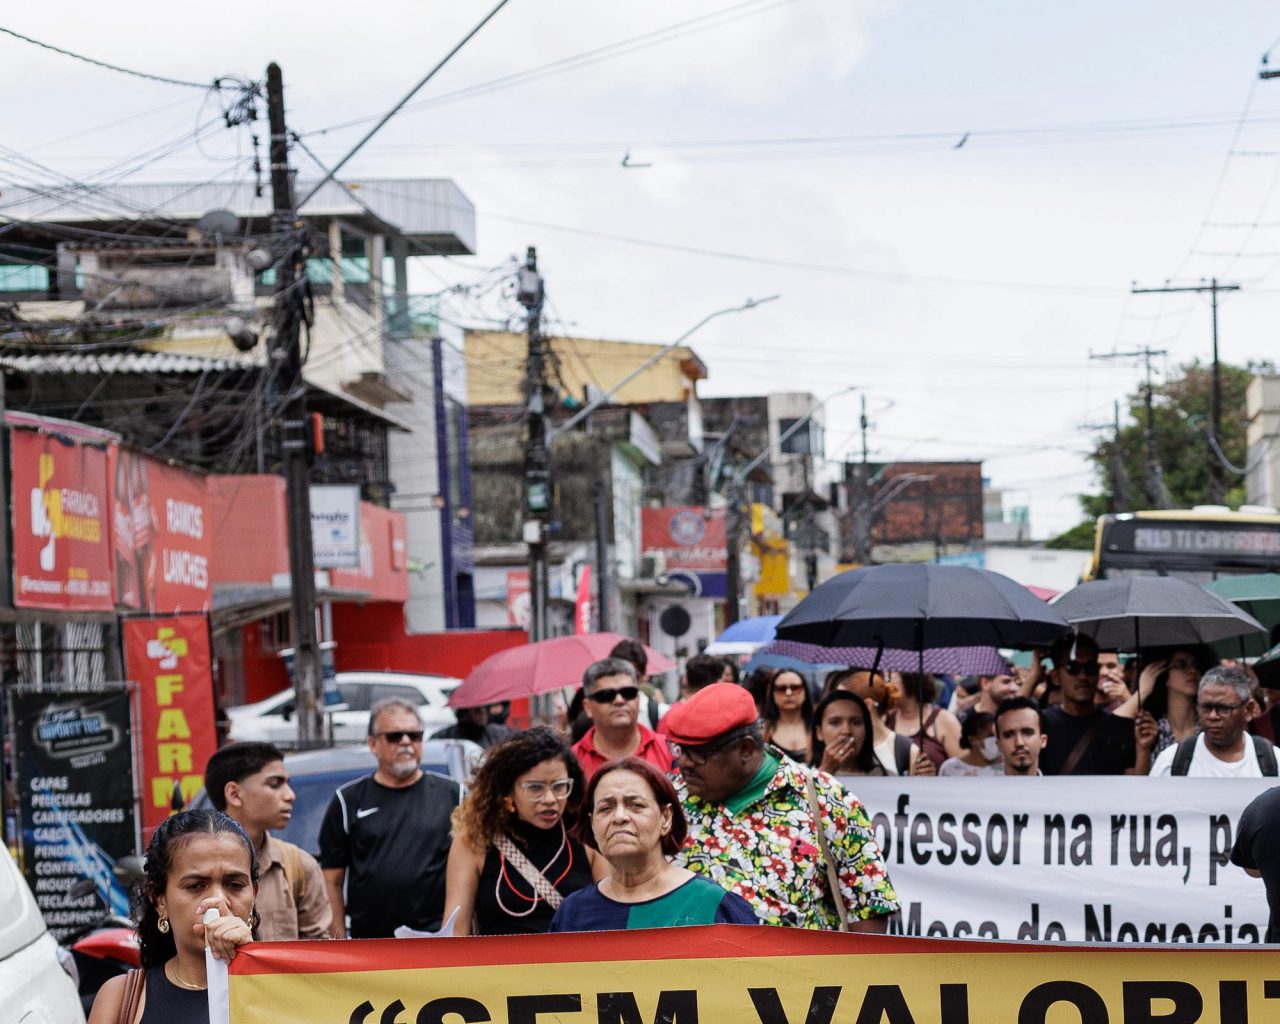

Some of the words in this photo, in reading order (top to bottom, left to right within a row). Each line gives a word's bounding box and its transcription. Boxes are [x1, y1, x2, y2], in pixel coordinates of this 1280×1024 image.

[31, 776, 69, 792] CAPAS
[33, 808, 125, 825] CARREGADORES
[872, 793, 1029, 867] ofessor
[1044, 813, 1093, 866] na
[1110, 813, 1191, 885] rua,
